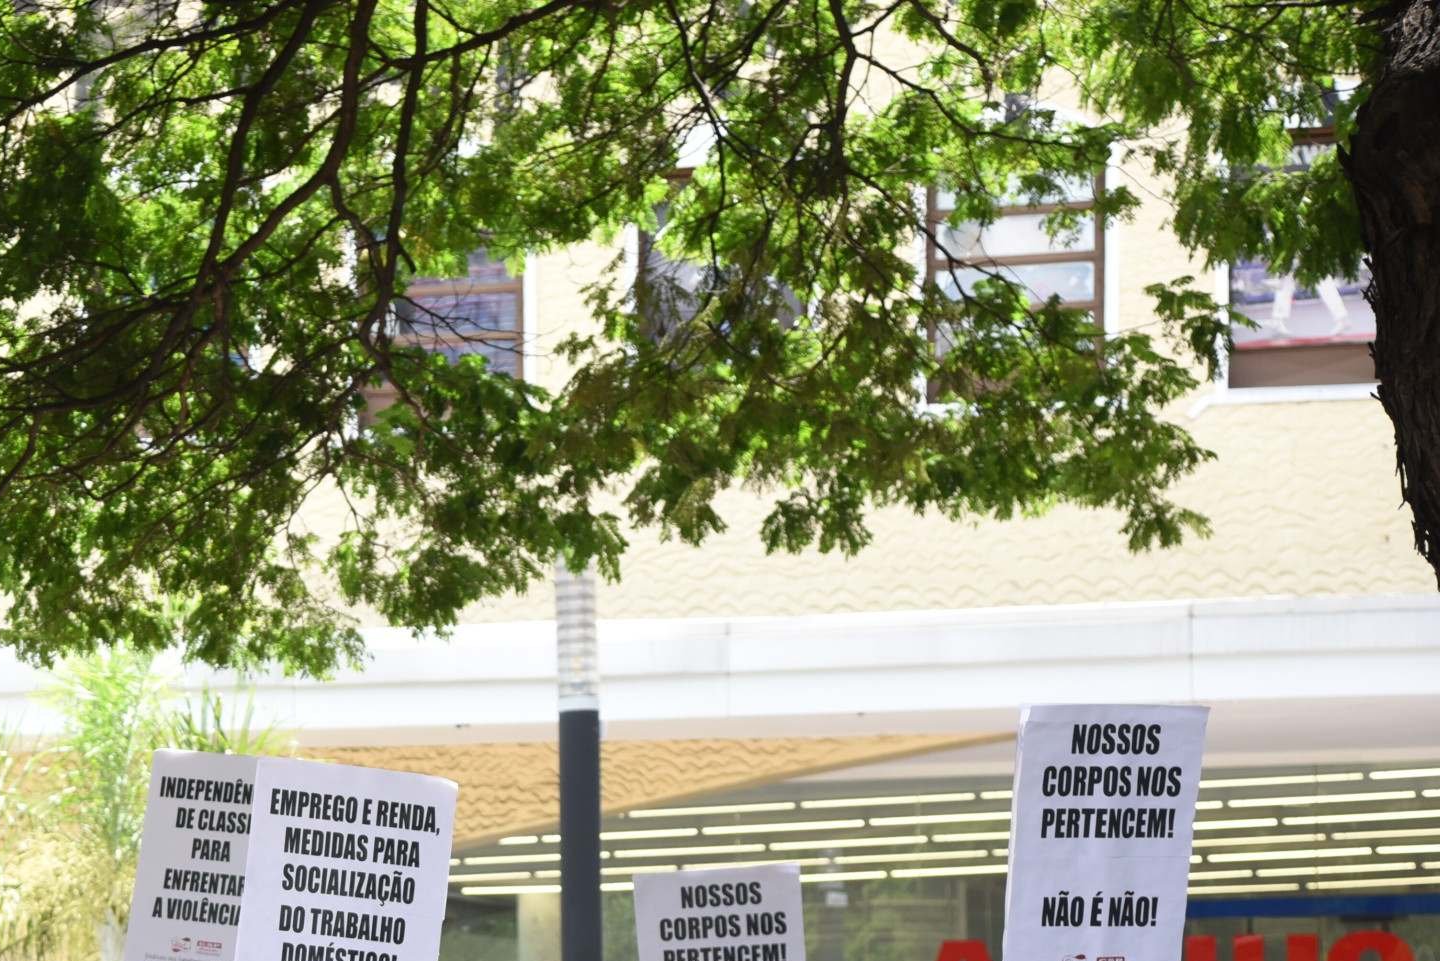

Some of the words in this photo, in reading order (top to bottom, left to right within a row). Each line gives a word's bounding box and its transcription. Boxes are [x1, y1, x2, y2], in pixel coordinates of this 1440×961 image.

[1071, 723, 1162, 755] NOSSOS
[160, 776, 254, 805] INDEPENDÊN
[1042, 765, 1132, 797] CORPOS
[1136, 766, 1182, 797] NOS
[176, 807, 196, 829] DE
[270, 788, 358, 824] EMPREGO
[362, 798, 372, 825] E
[376, 800, 440, 836] RENDA,
[1040, 808, 1176, 839] PERTENCEM!
[191, 838, 230, 862] PARA
[284, 826, 368, 862] MEDIDAS
[372, 836, 420, 868] PARA
[282, 864, 415, 907] SOCIALIZAÇÃO
[680, 881, 762, 909] NOSSOS
[152, 897, 162, 918] A
[1041, 890, 1084, 927] NÃO
[1090, 891, 1104, 927] É
[1108, 890, 1158, 928] NÃO!
[278, 905, 305, 933] DO
[310, 908, 406, 946] TRABALHO
[660, 914, 741, 942] CORPOS
[746, 911, 787, 936] NOS
